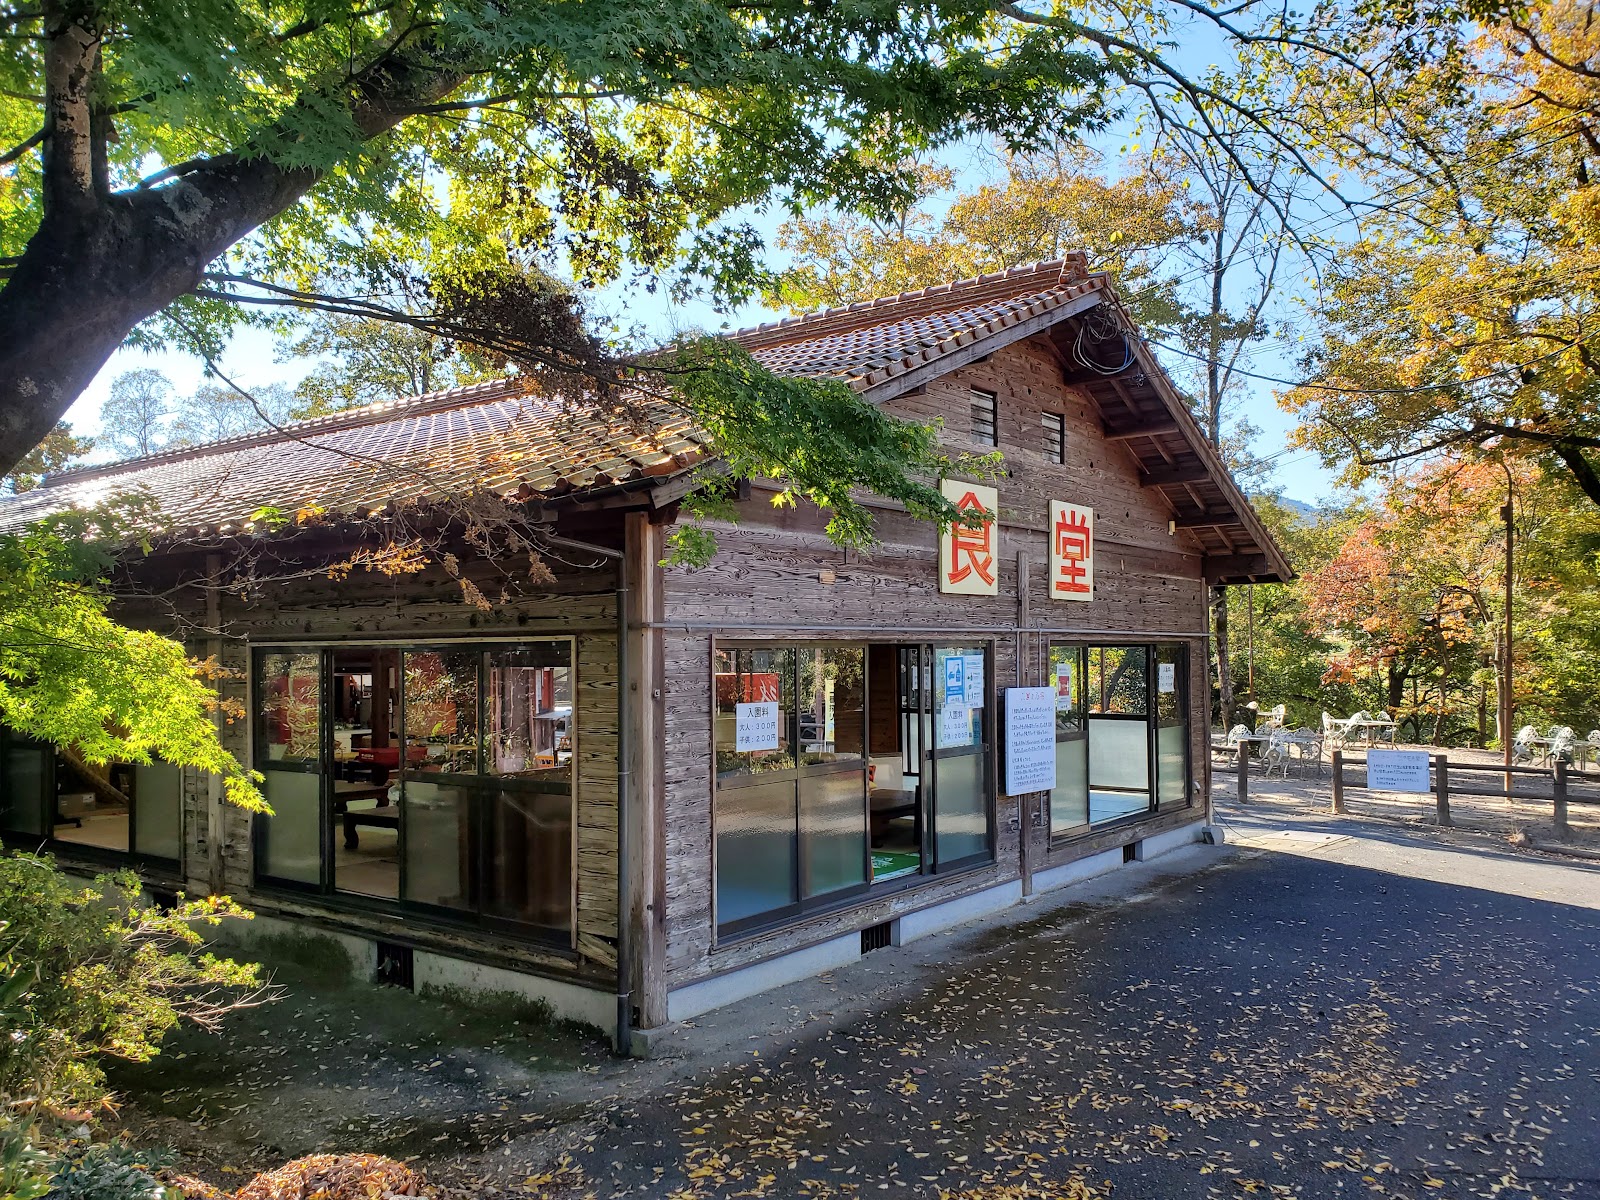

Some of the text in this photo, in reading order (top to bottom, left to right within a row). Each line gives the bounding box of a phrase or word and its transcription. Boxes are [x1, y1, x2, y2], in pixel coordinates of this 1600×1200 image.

[947, 491, 1091, 593] 食 堂
[747, 706, 769, 718] 入園料
